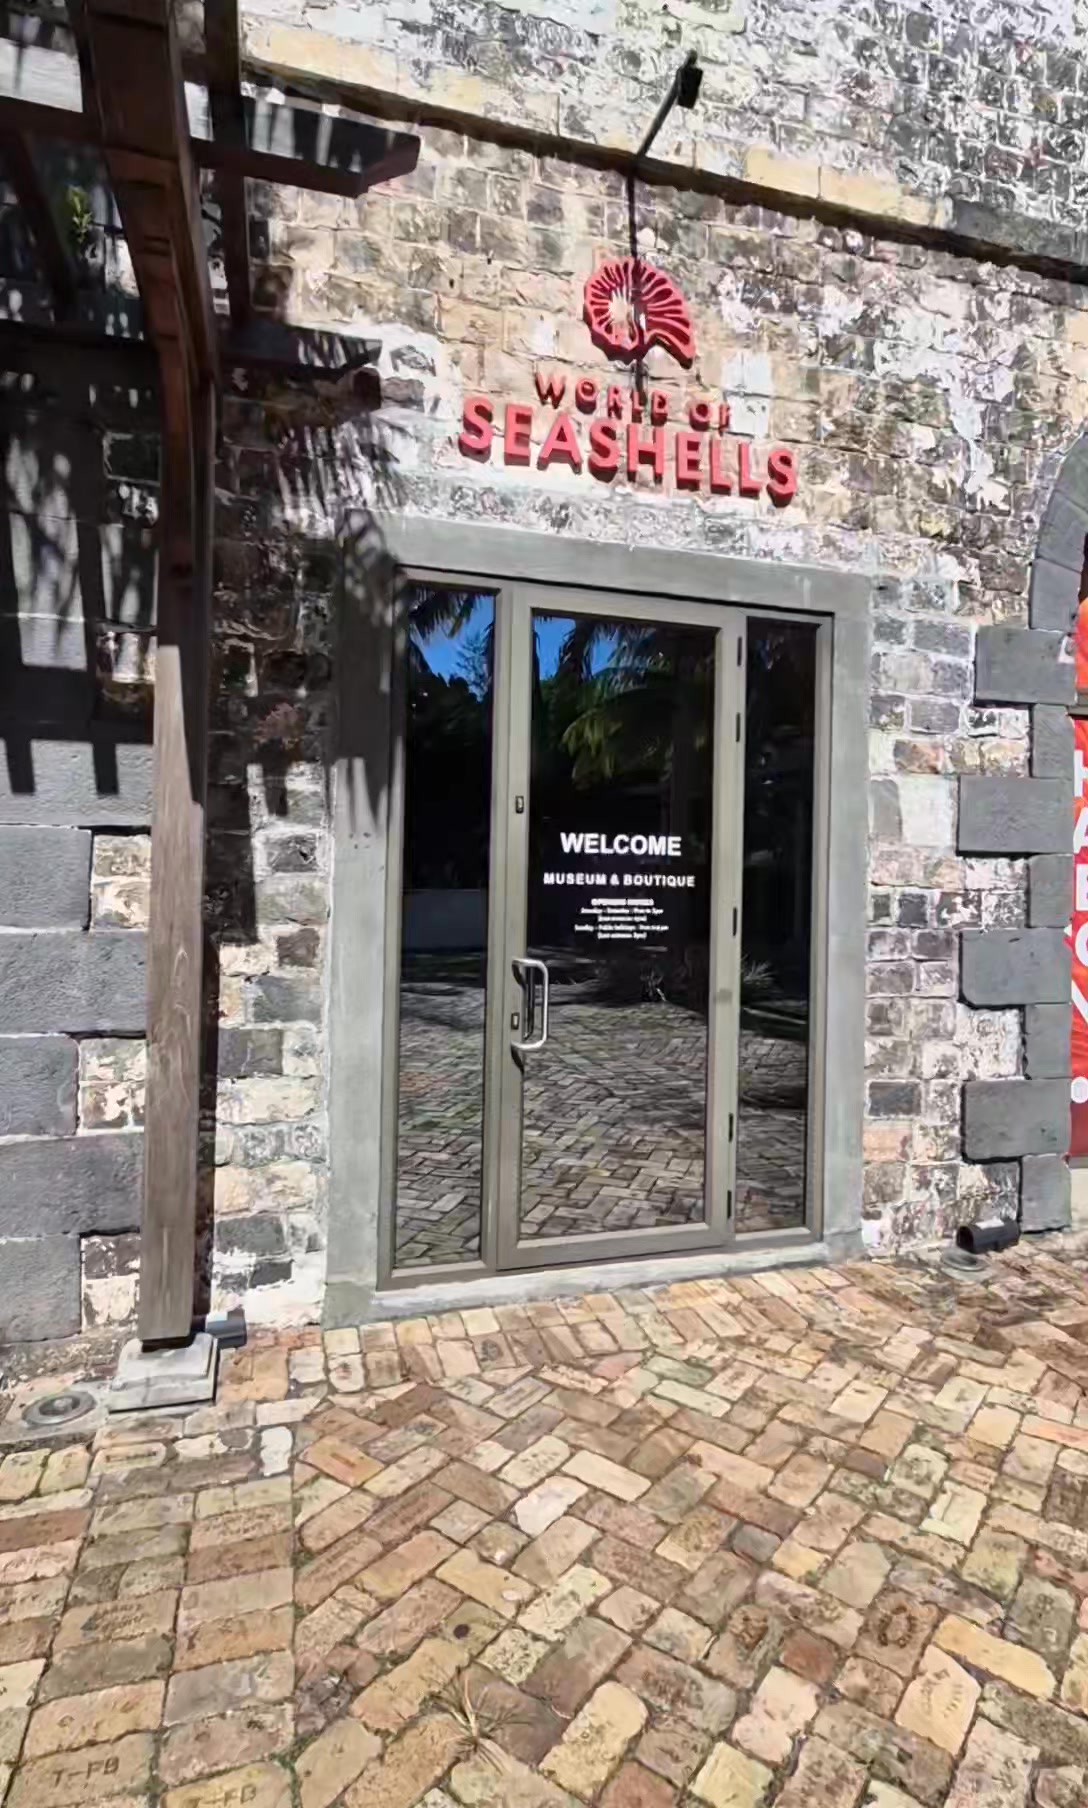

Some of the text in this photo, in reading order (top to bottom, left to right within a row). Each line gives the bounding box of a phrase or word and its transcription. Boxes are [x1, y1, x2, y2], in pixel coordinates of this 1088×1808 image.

[535, 371, 733, 432] WORLD OF
[459, 395, 798, 507] SEASHELLS
[560, 831, 683, 857] WELCOME
[543, 871, 696, 888] MUSEUM & BOUTIQUE
